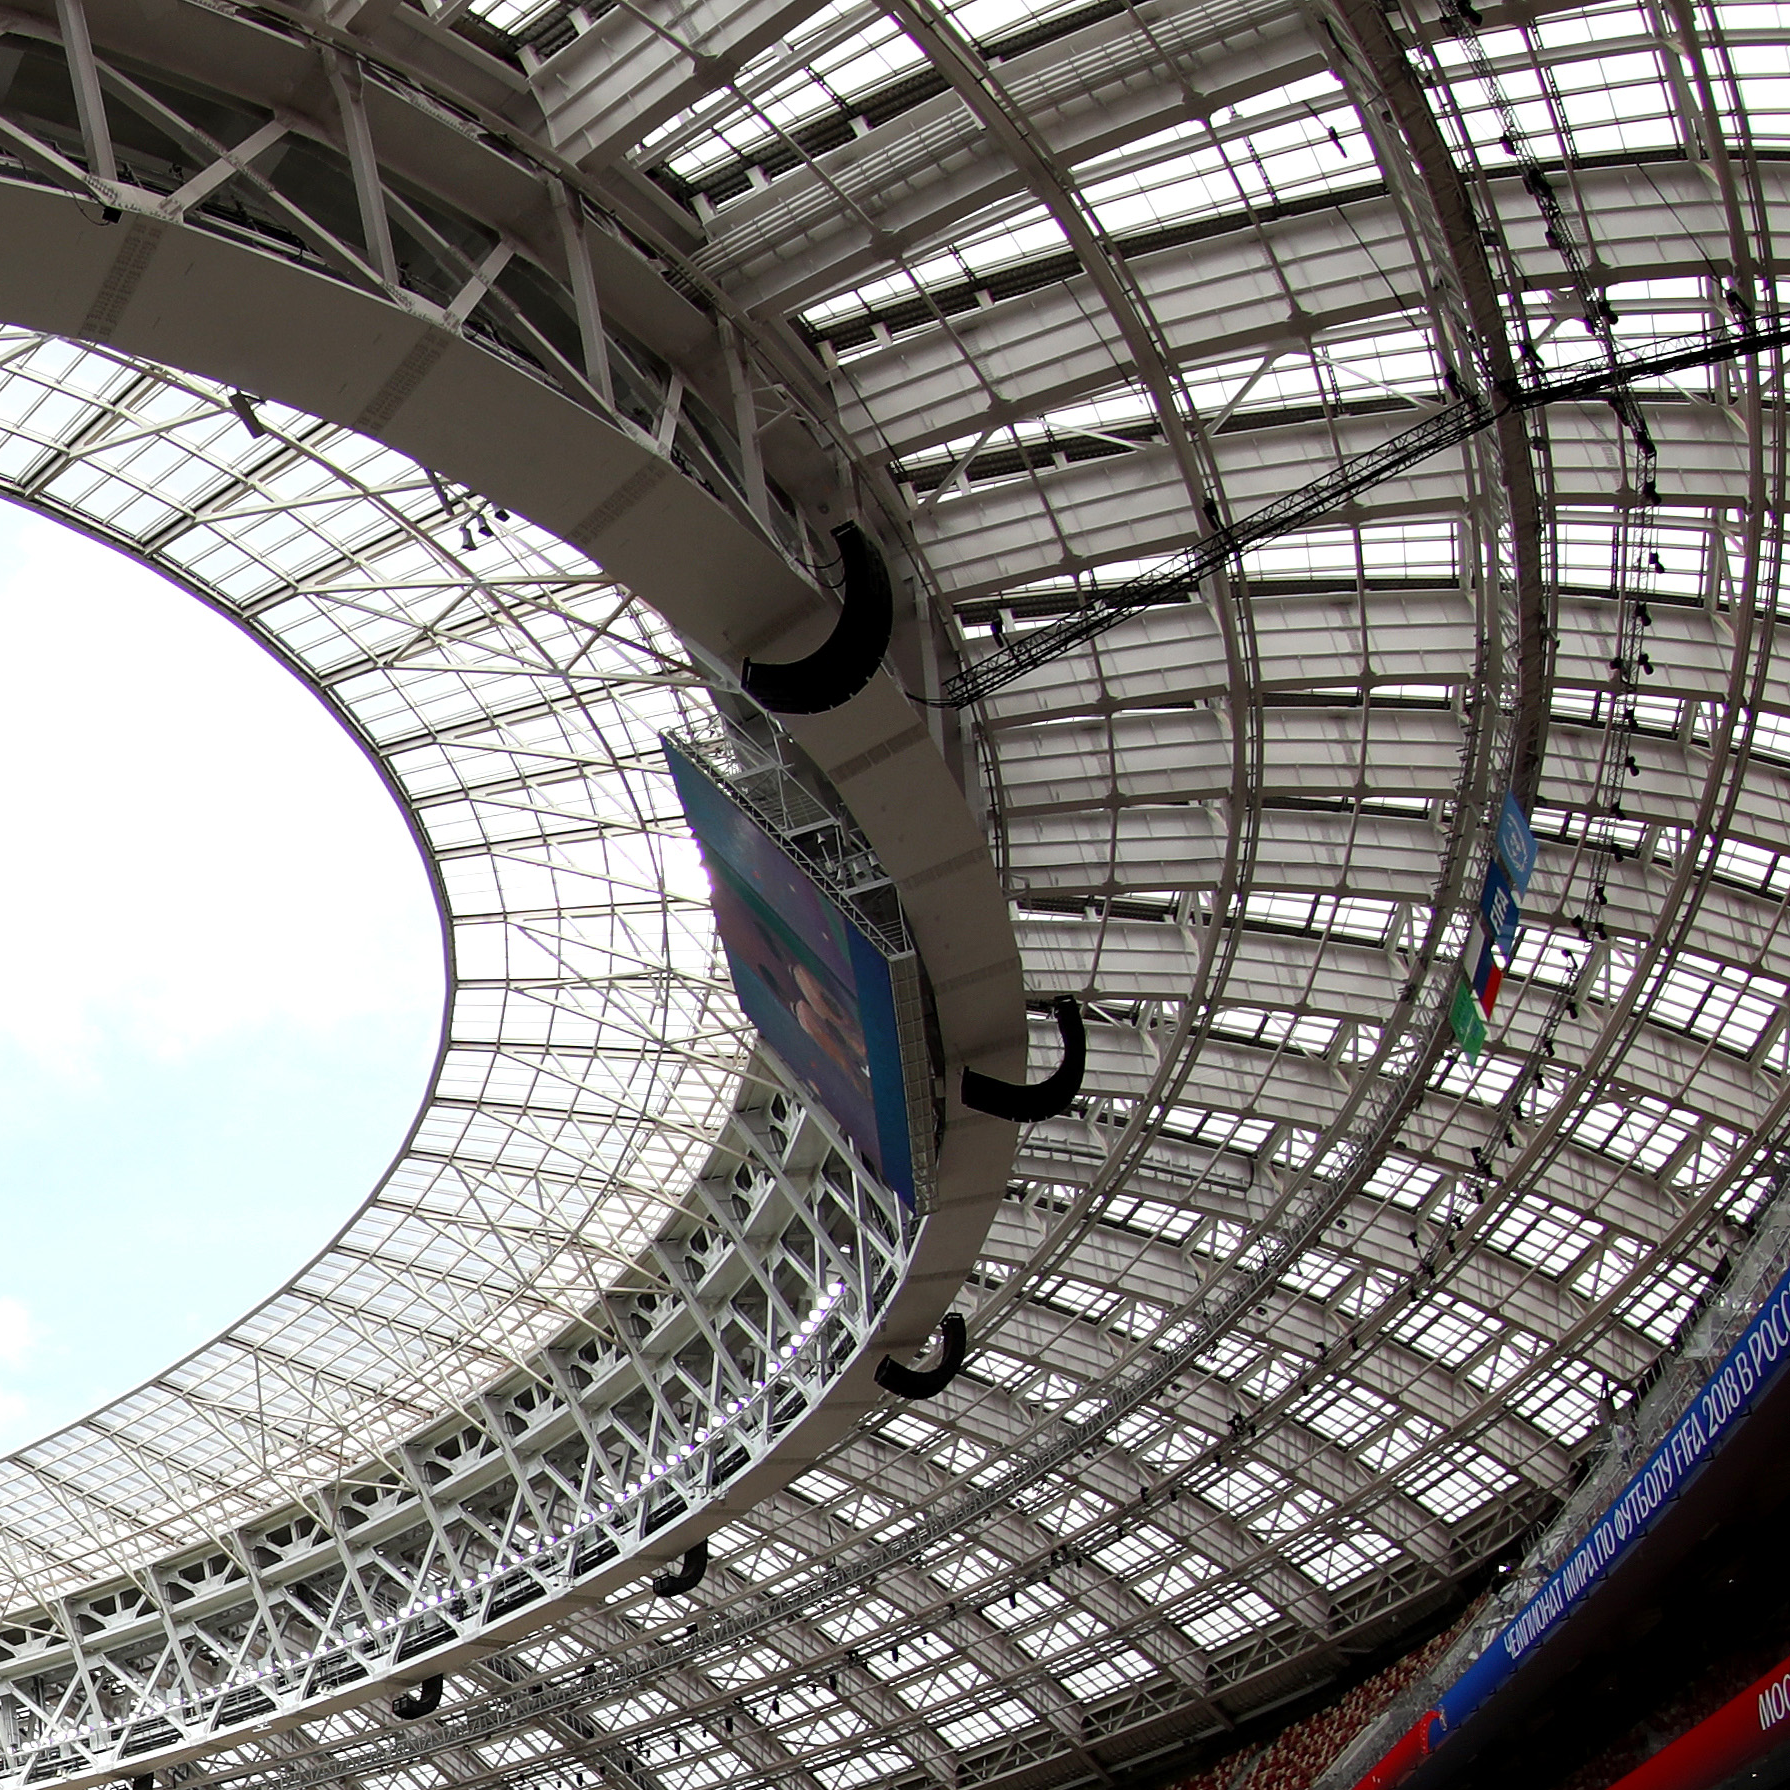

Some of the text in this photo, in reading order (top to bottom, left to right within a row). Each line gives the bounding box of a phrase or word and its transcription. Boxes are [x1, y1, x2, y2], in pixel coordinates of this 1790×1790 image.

[1503, 1578, 1565, 1660] ЧЕМПИОНАТ
[1562, 1542, 1599, 1602] МИРА
[1593, 1521, 1616, 1565] ПО
[1614, 1447, 1673, 1541] ФУТБОЛУ
[1671, 1412, 1707, 1476] FIFA
[1702, 1366, 1741, 1439] 2018
[1735, 1351, 1753, 1396] В
